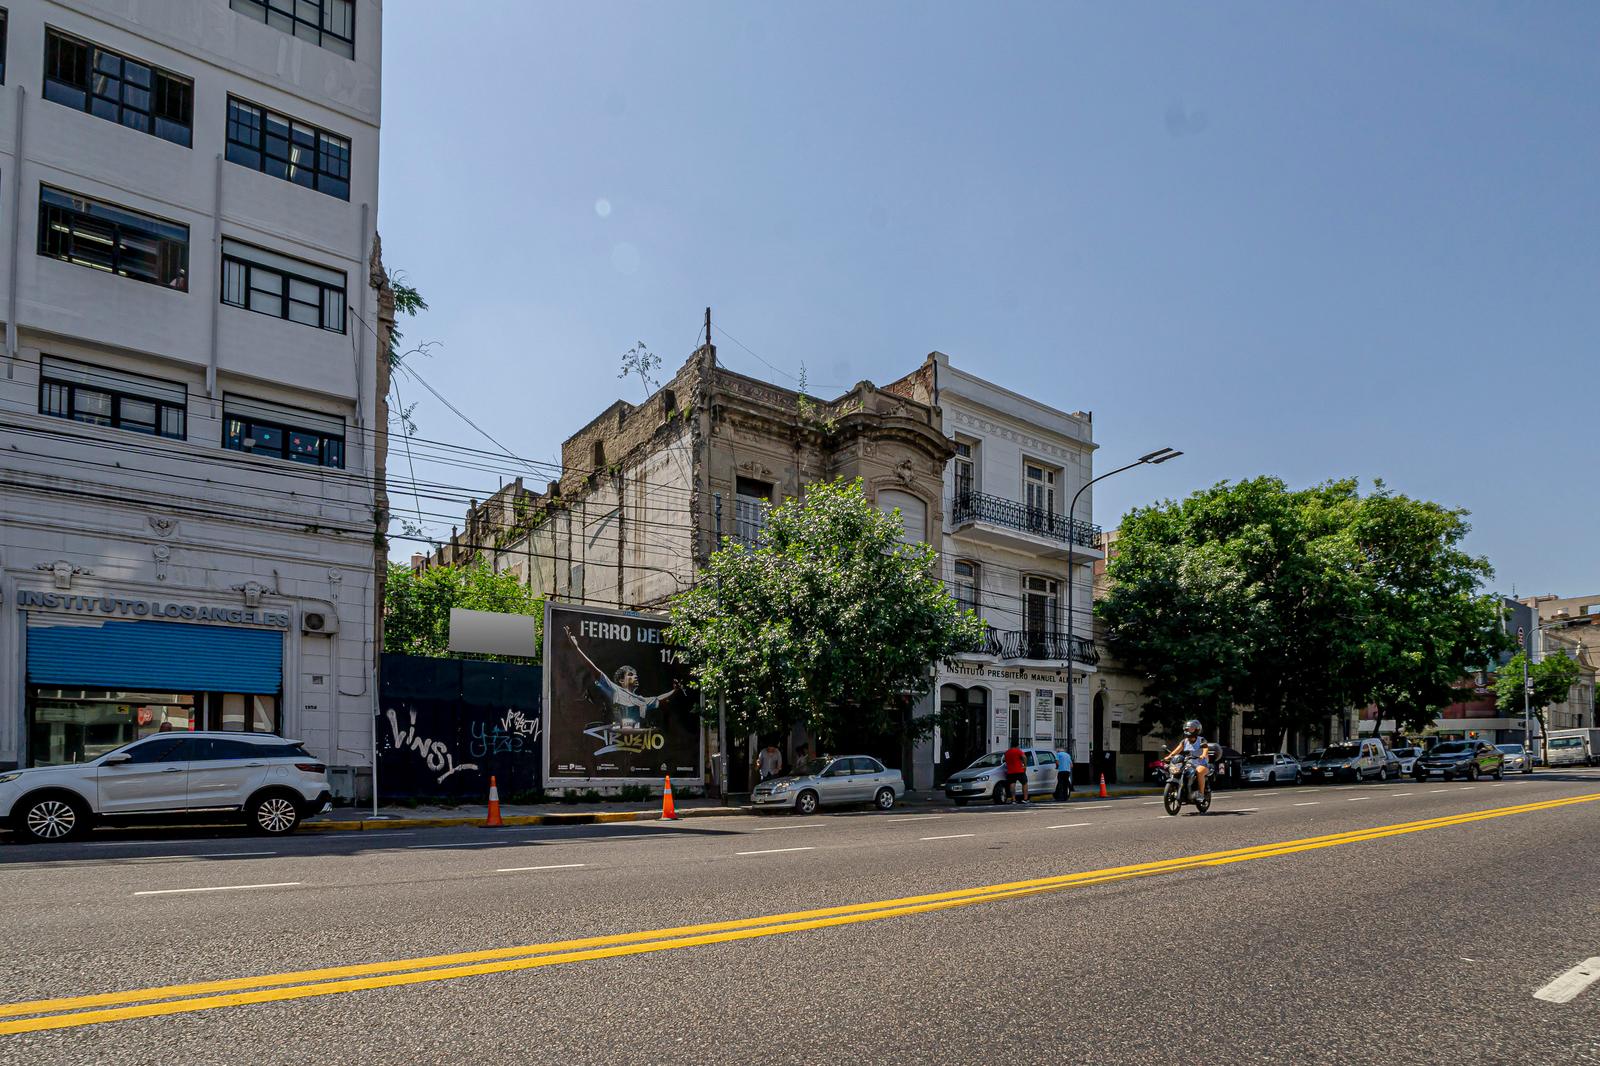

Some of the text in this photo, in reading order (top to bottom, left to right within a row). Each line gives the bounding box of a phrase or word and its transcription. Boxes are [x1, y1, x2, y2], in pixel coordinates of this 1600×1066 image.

[17, 590, 289, 627] INSTITUTO LOS ANGELES
[580, 620, 632, 642] FERRO
[946, 665, 1083, 685] INSTITUTO PRESBITERO MANUEL ALRTI
